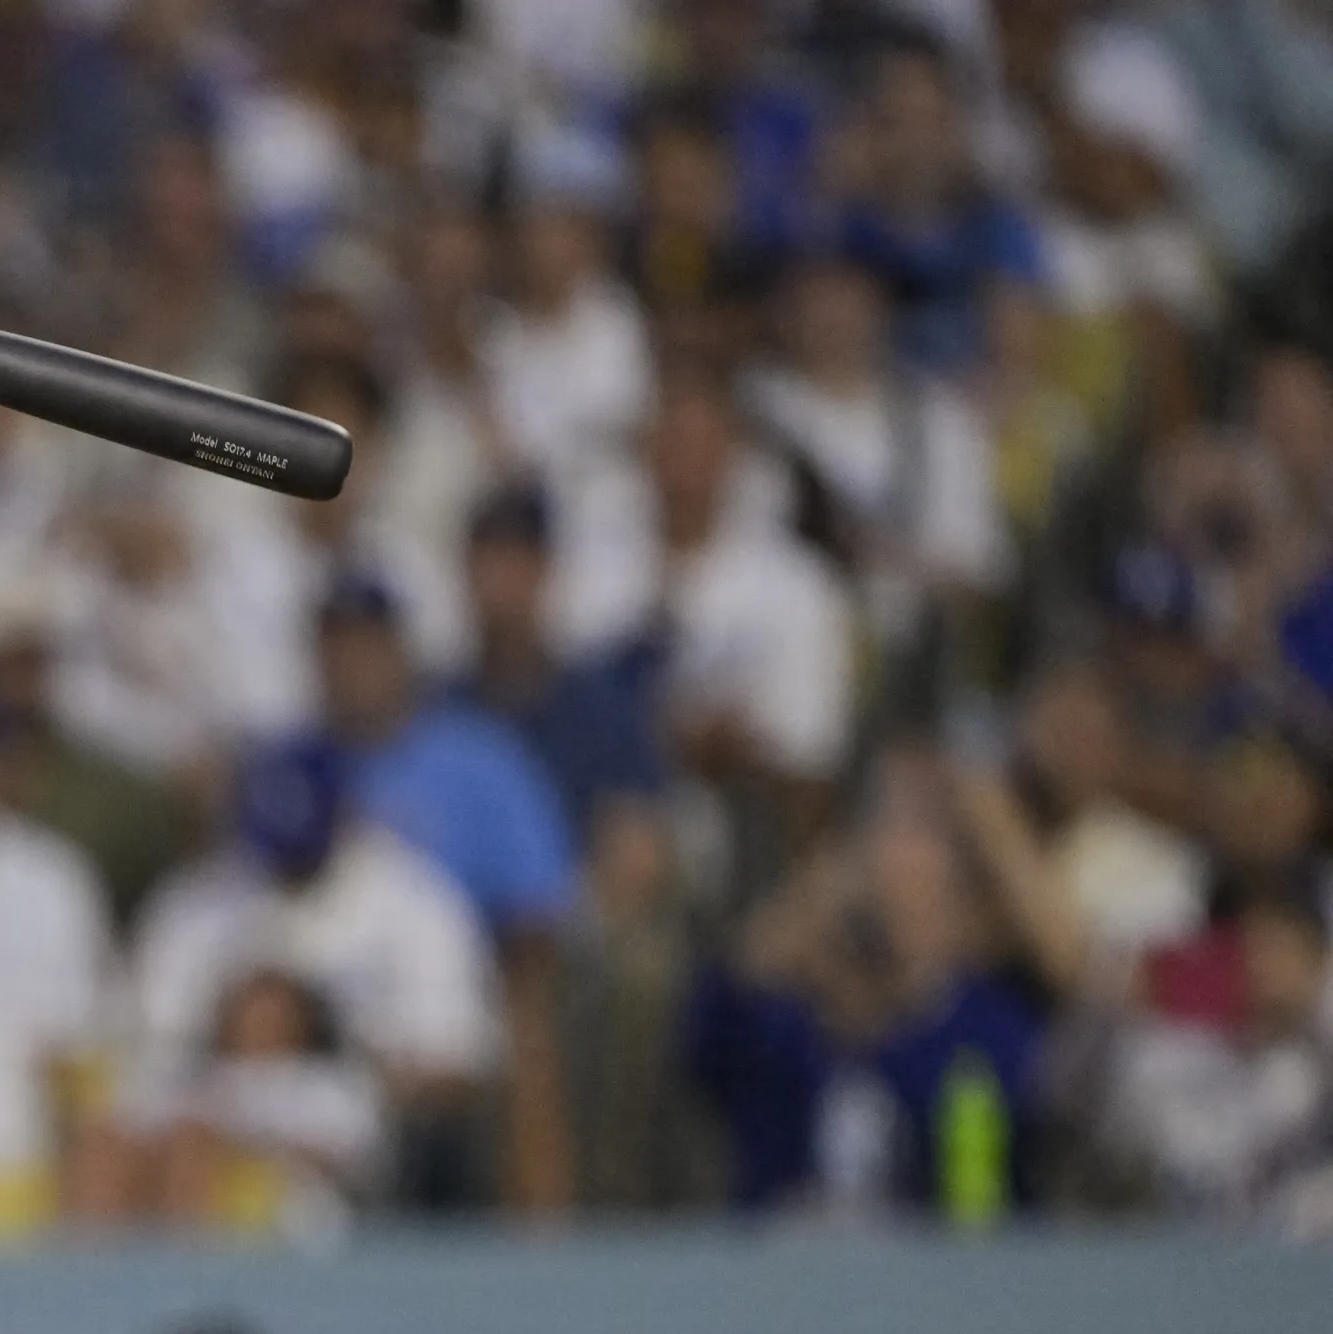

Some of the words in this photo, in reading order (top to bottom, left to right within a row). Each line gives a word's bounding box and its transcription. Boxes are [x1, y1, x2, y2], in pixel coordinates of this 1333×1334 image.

[190, 431, 219, 449] Model
[256, 452, 289, 470] MAPLE
[194, 449, 234, 468] SHOHEI
[235, 461, 275, 480] OHTANI
